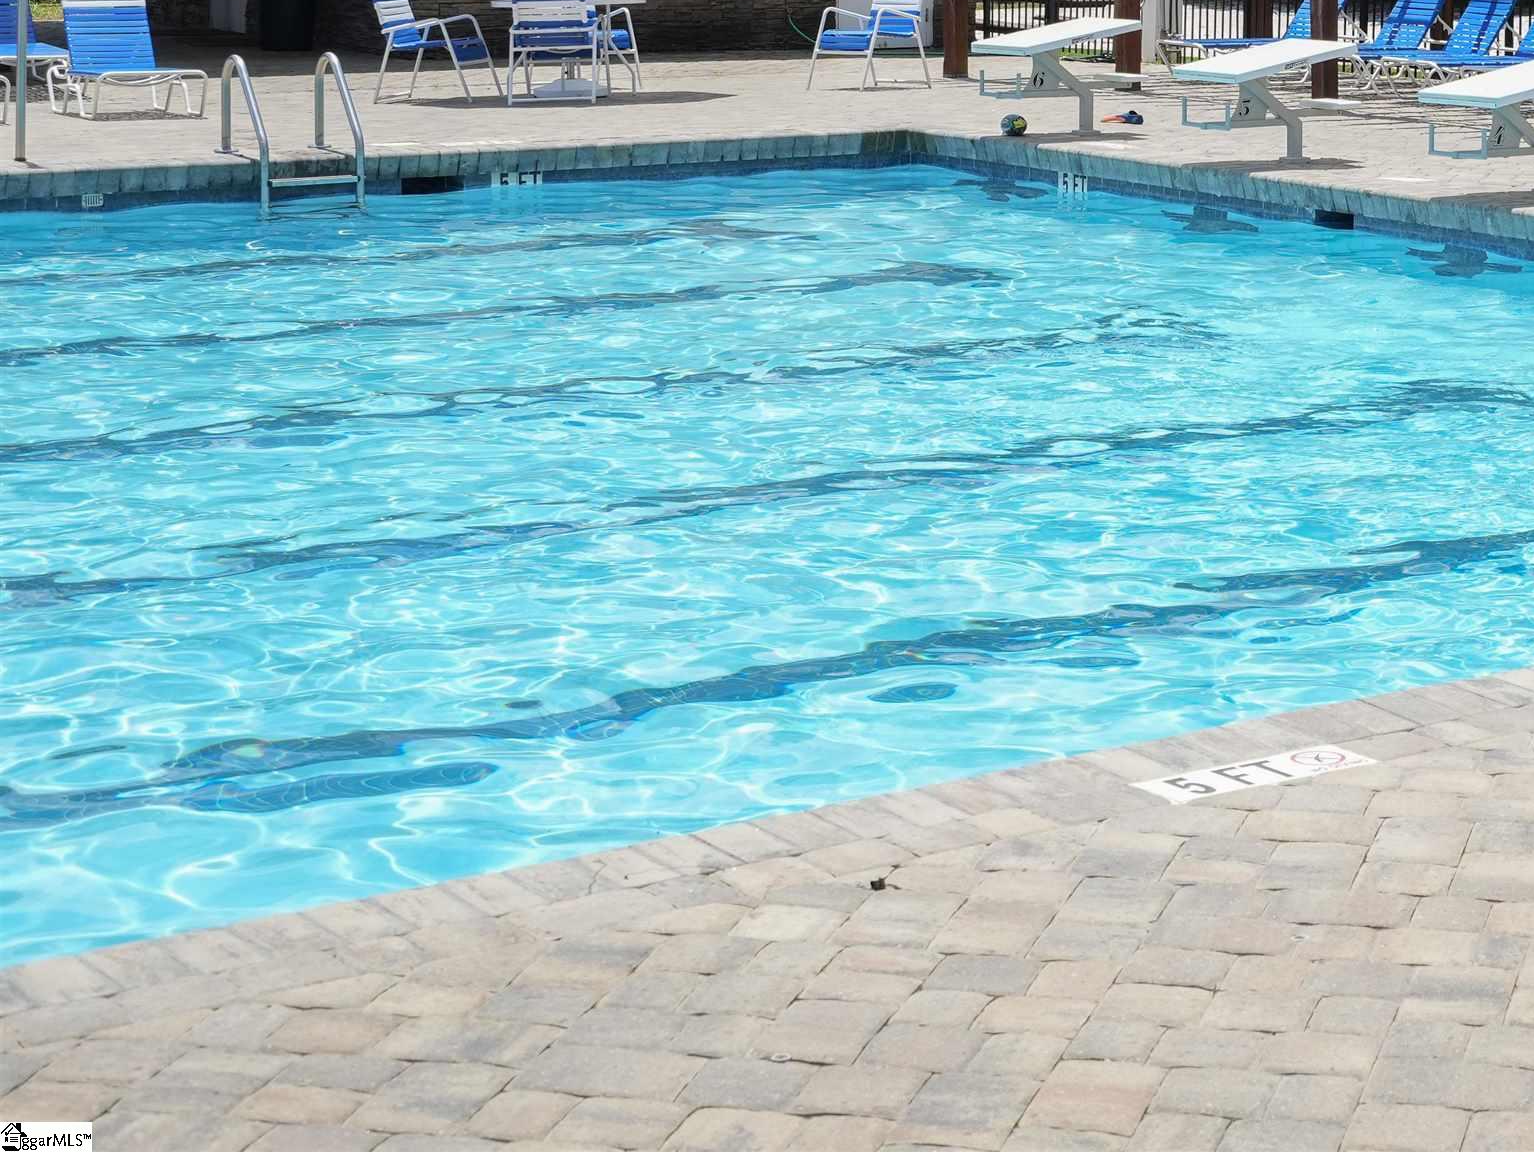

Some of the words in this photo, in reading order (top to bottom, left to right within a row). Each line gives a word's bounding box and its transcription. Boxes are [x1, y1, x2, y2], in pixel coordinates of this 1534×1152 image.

[1033, 71, 1045, 88] 6
[1239, 99, 1251, 116] 5
[500, 172, 509, 186] 5
[518, 171, 541, 185] FT
[1062, 172, 1069, 193] 5
[1073, 174, 1087, 193] FT
[1163, 777, 1217, 795] 5
[1211, 759, 1294, 786] FT
